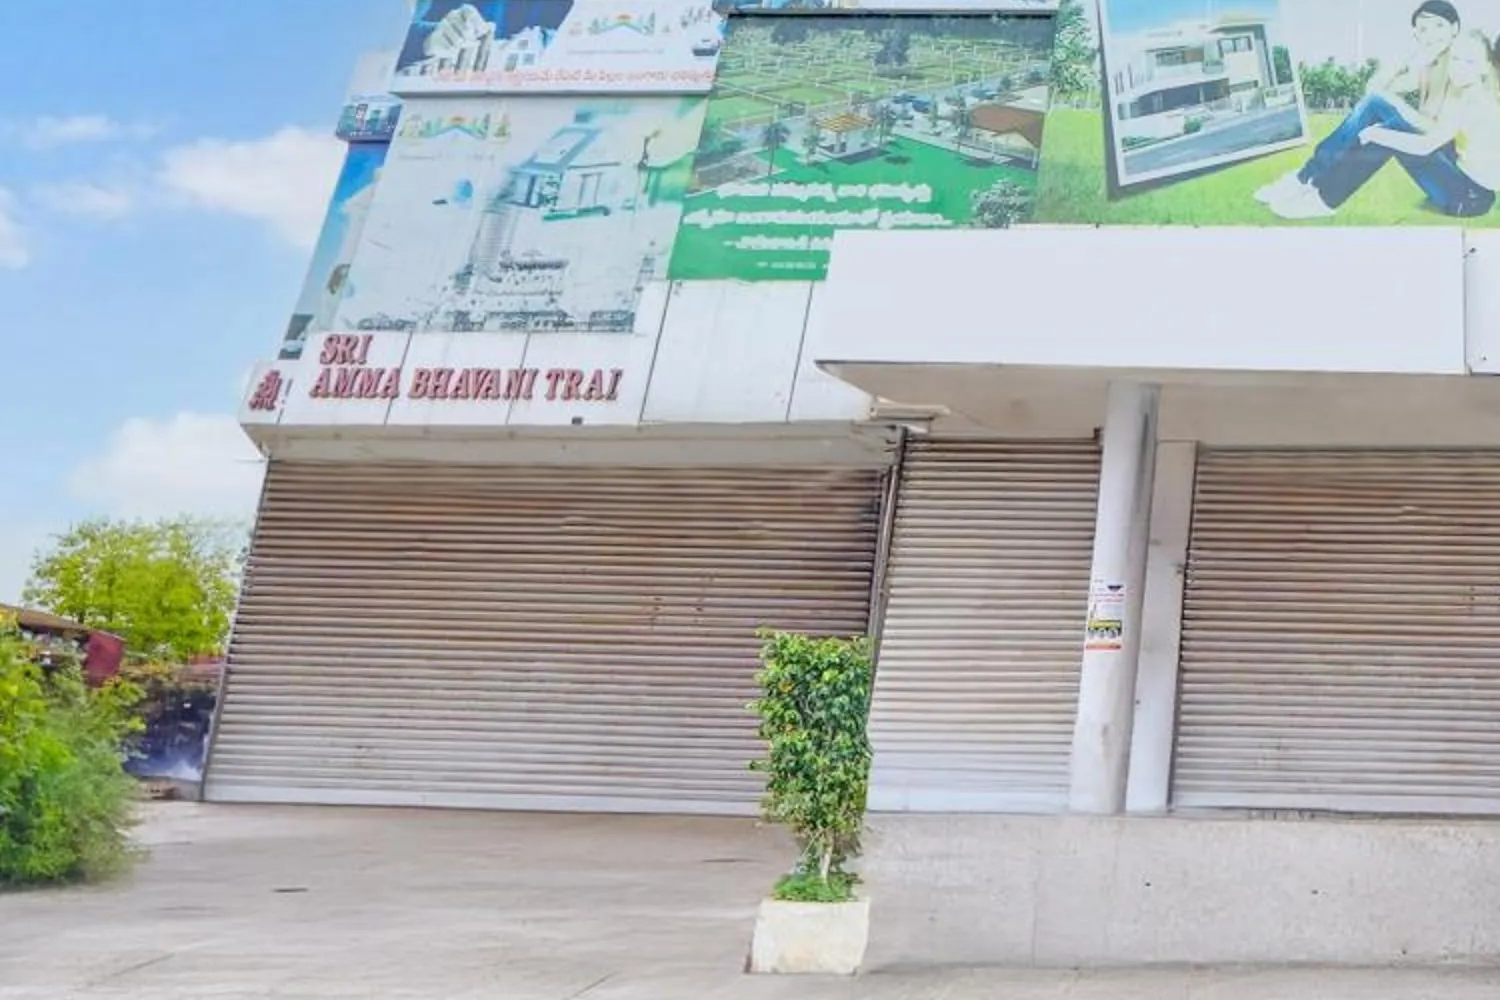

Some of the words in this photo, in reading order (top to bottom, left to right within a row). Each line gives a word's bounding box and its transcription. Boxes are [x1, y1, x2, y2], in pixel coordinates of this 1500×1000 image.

[320, 334, 373, 365] SRI
[309, 367, 402, 399] AMMA
[407, 368, 539, 400] BHAVANI
[545, 369, 623, 401] TRAI
